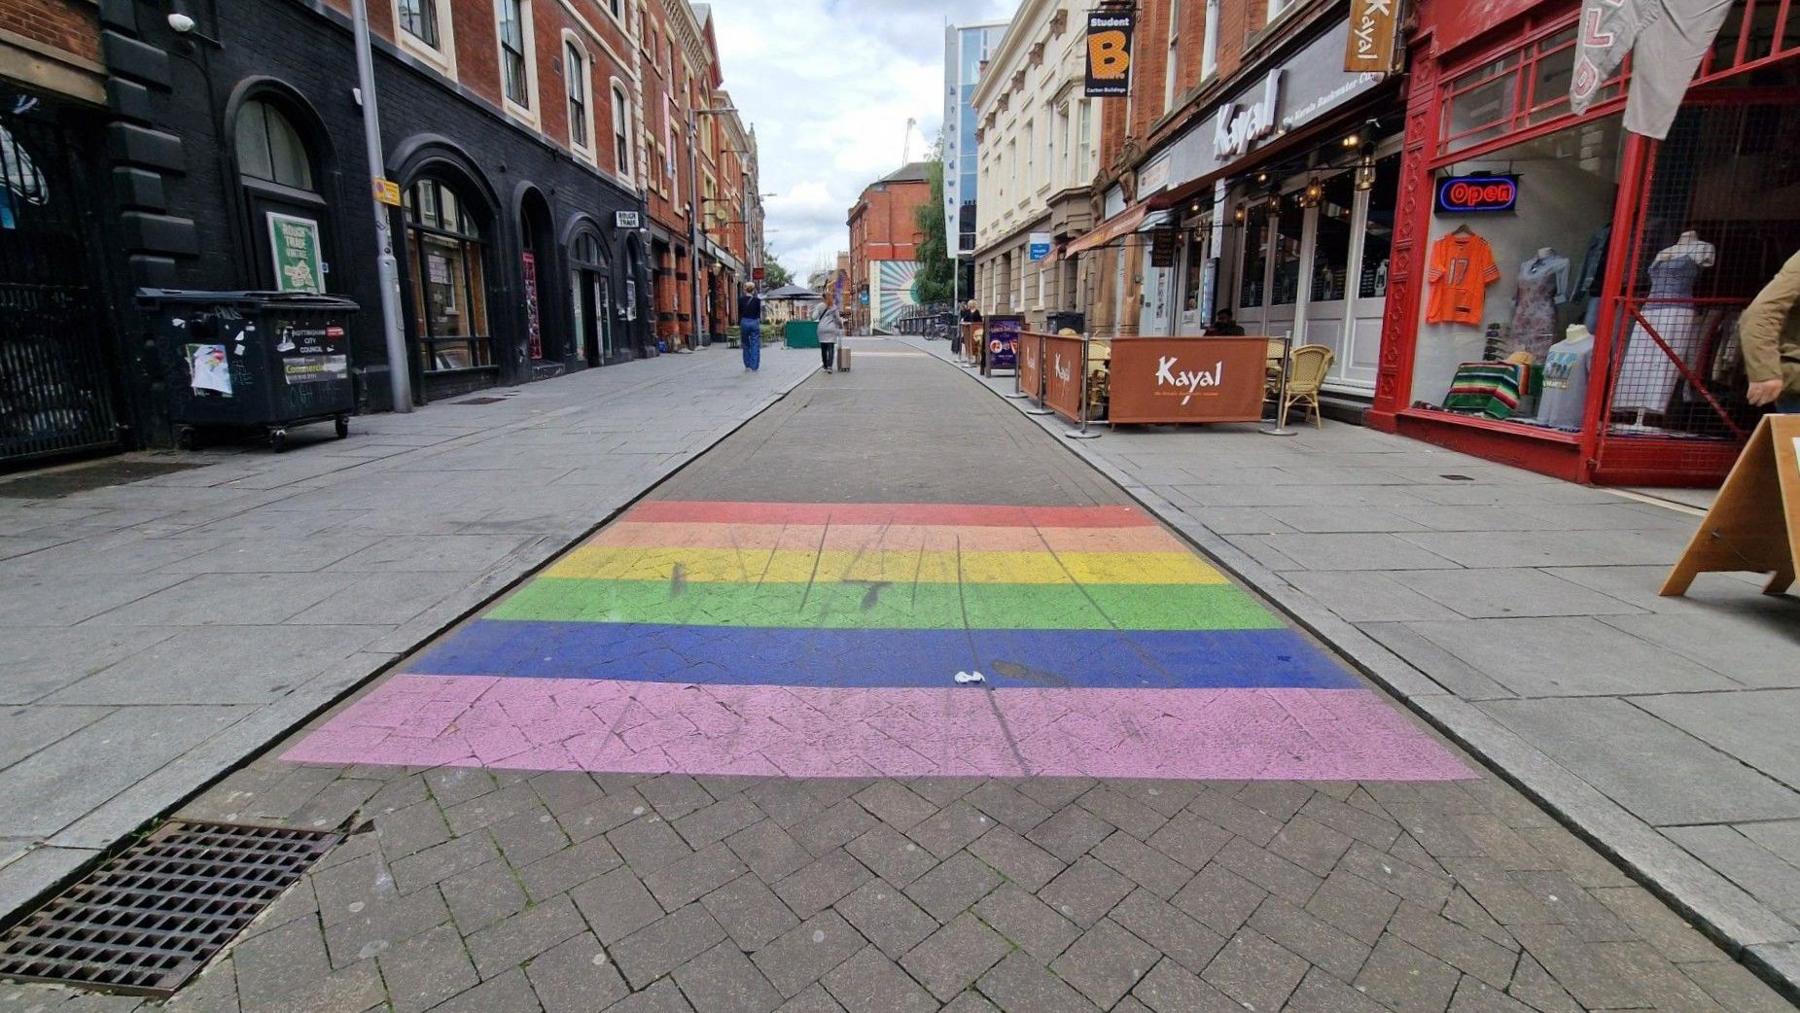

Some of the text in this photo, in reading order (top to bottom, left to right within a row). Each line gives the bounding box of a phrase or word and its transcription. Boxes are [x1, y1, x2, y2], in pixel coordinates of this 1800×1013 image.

[1090, 17, 1130, 27] Student
[1353, 0, 1391, 58] Kayal
[1088, 30, 1130, 79] B
[1213, 68, 1283, 161] Kayal
[1450, 182, 1513, 206] Open
[1449, 257, 1469, 285] 17
[1155, 355, 1222, 406] Kayal
